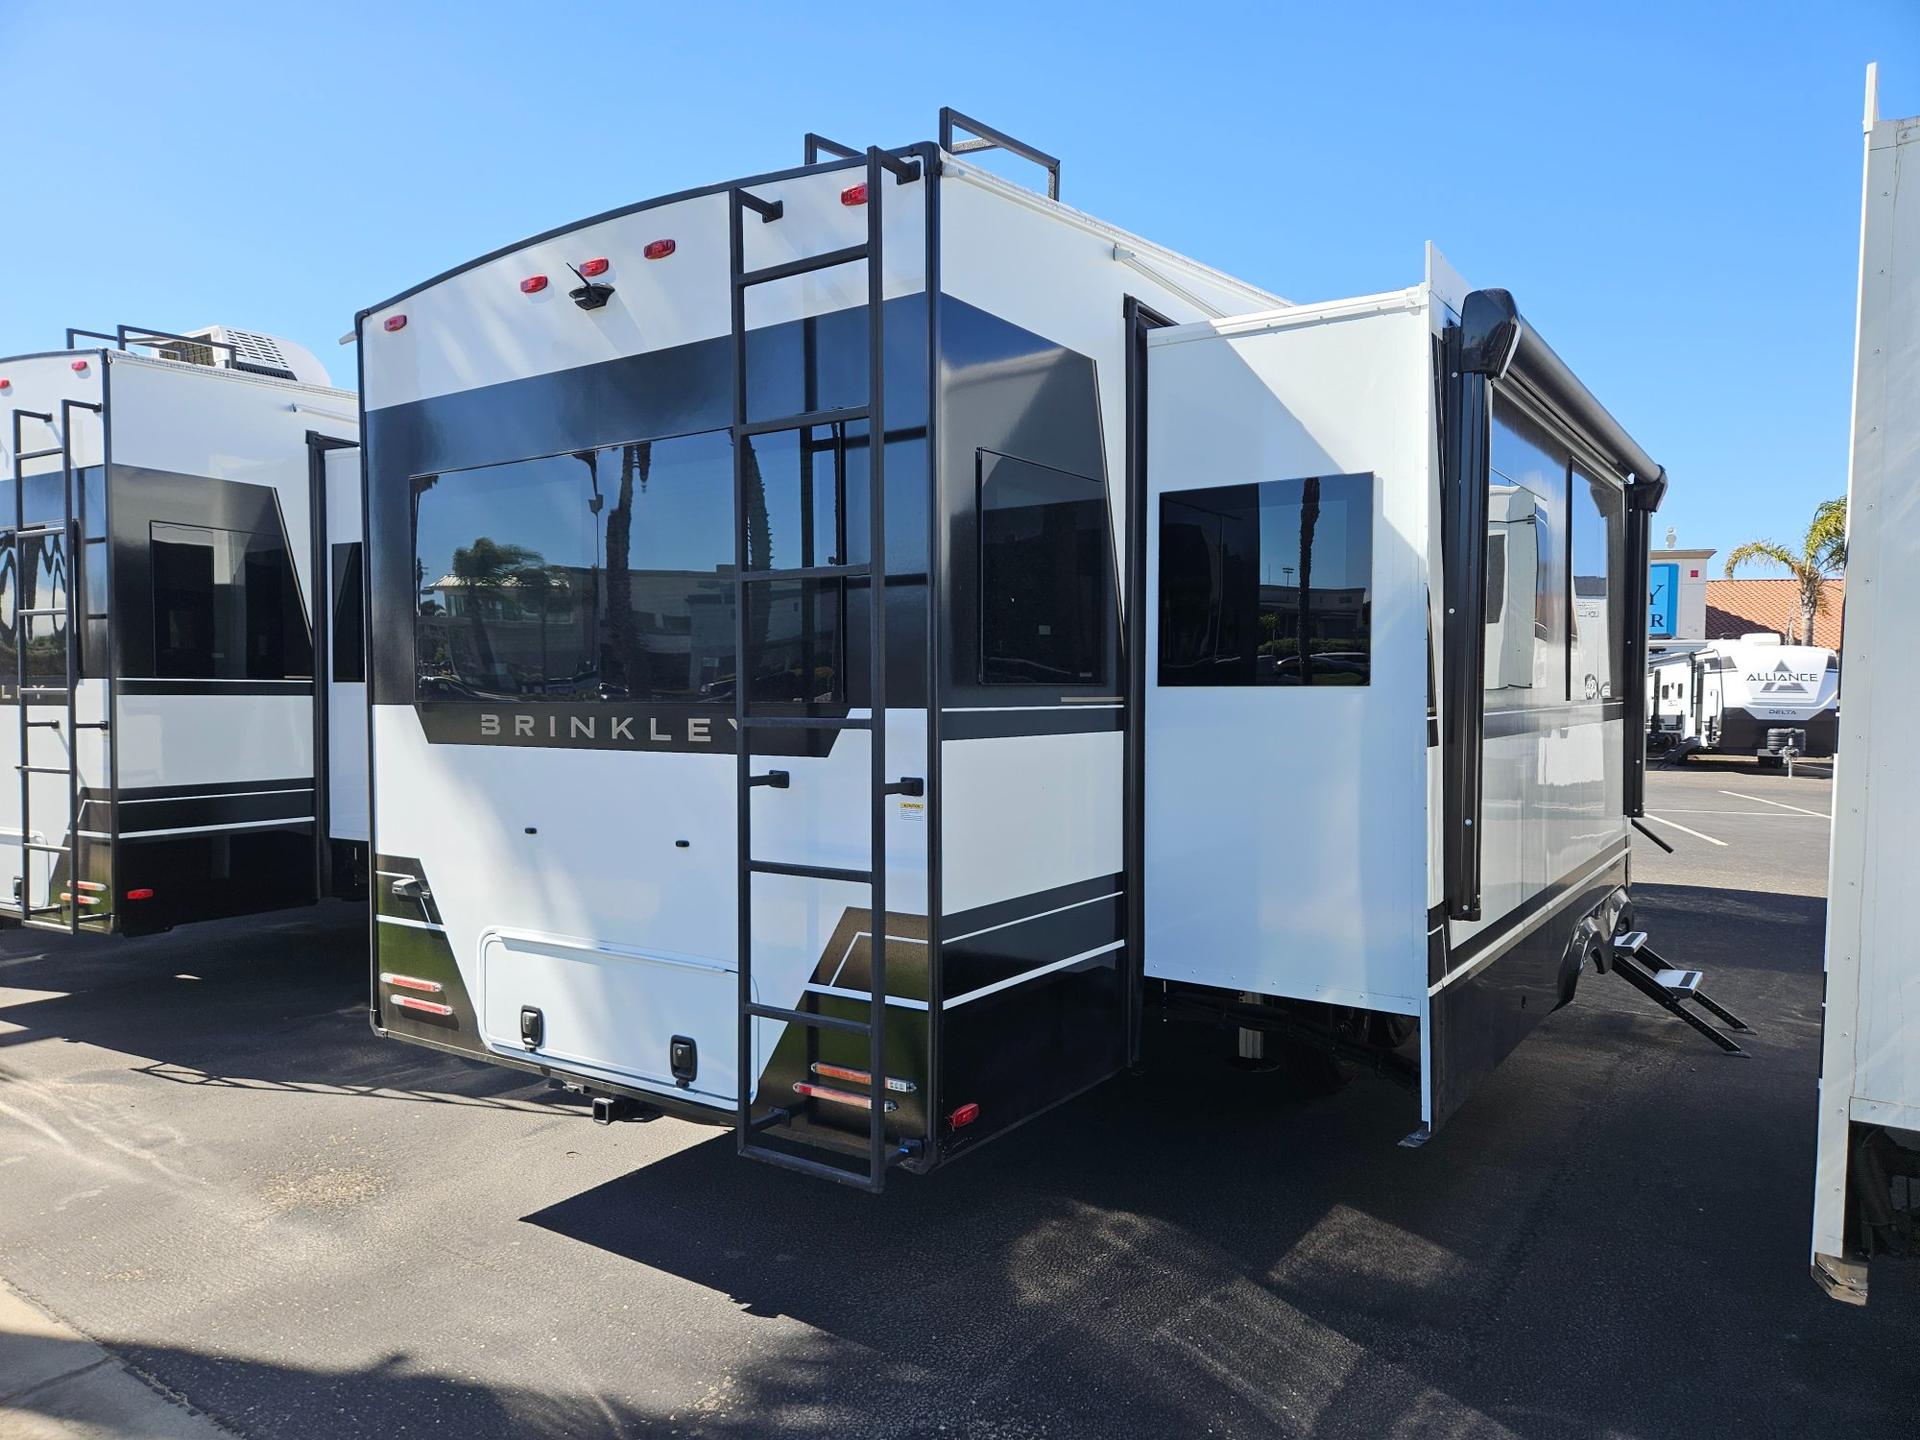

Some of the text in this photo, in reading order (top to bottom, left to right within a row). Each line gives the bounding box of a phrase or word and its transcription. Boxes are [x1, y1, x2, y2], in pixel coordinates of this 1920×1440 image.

[1650, 614, 1664, 627] R
[1746, 672, 1818, 682] ALLIANCE
[481, 715, 737, 742] BRINKLE
